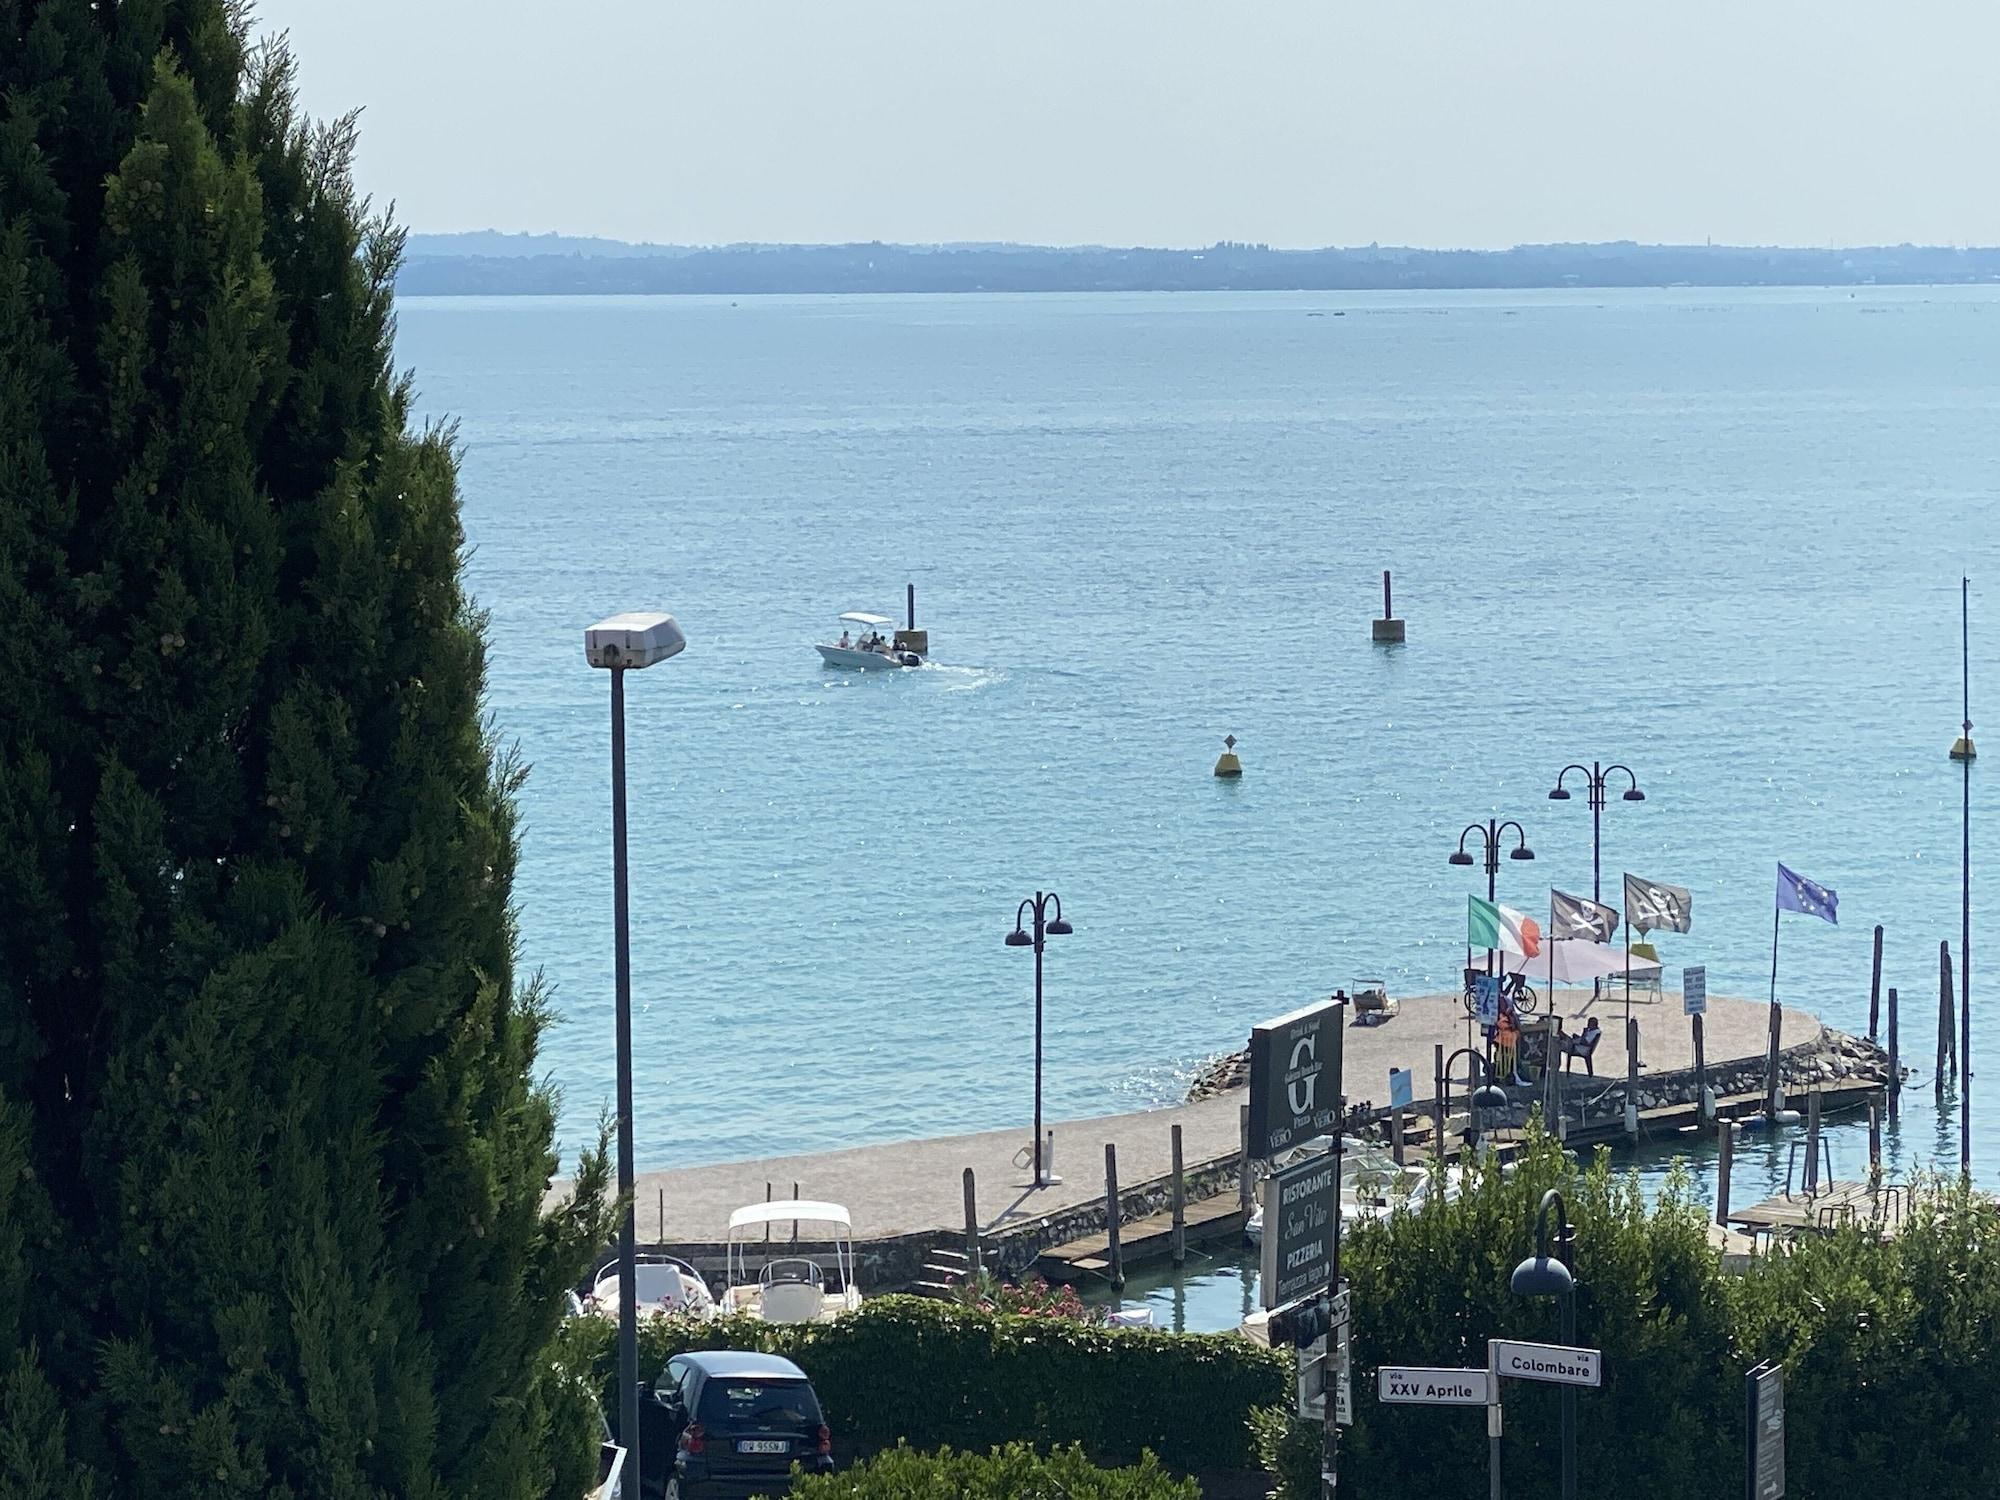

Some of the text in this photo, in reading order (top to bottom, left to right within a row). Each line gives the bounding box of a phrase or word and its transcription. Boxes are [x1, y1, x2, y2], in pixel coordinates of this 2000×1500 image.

[1283, 1168, 1332, 1205] RISTORANTE
[1285, 1201, 1327, 1240] San Vito
[1287, 1239, 1323, 1271] PIZZERIA
[1511, 1356, 1590, 1377] Colombare
[1577, 1354, 1590, 1363] via
[1389, 1372, 1403, 1380] via
[1390, 1383, 1472, 1399] XXV Aprile
